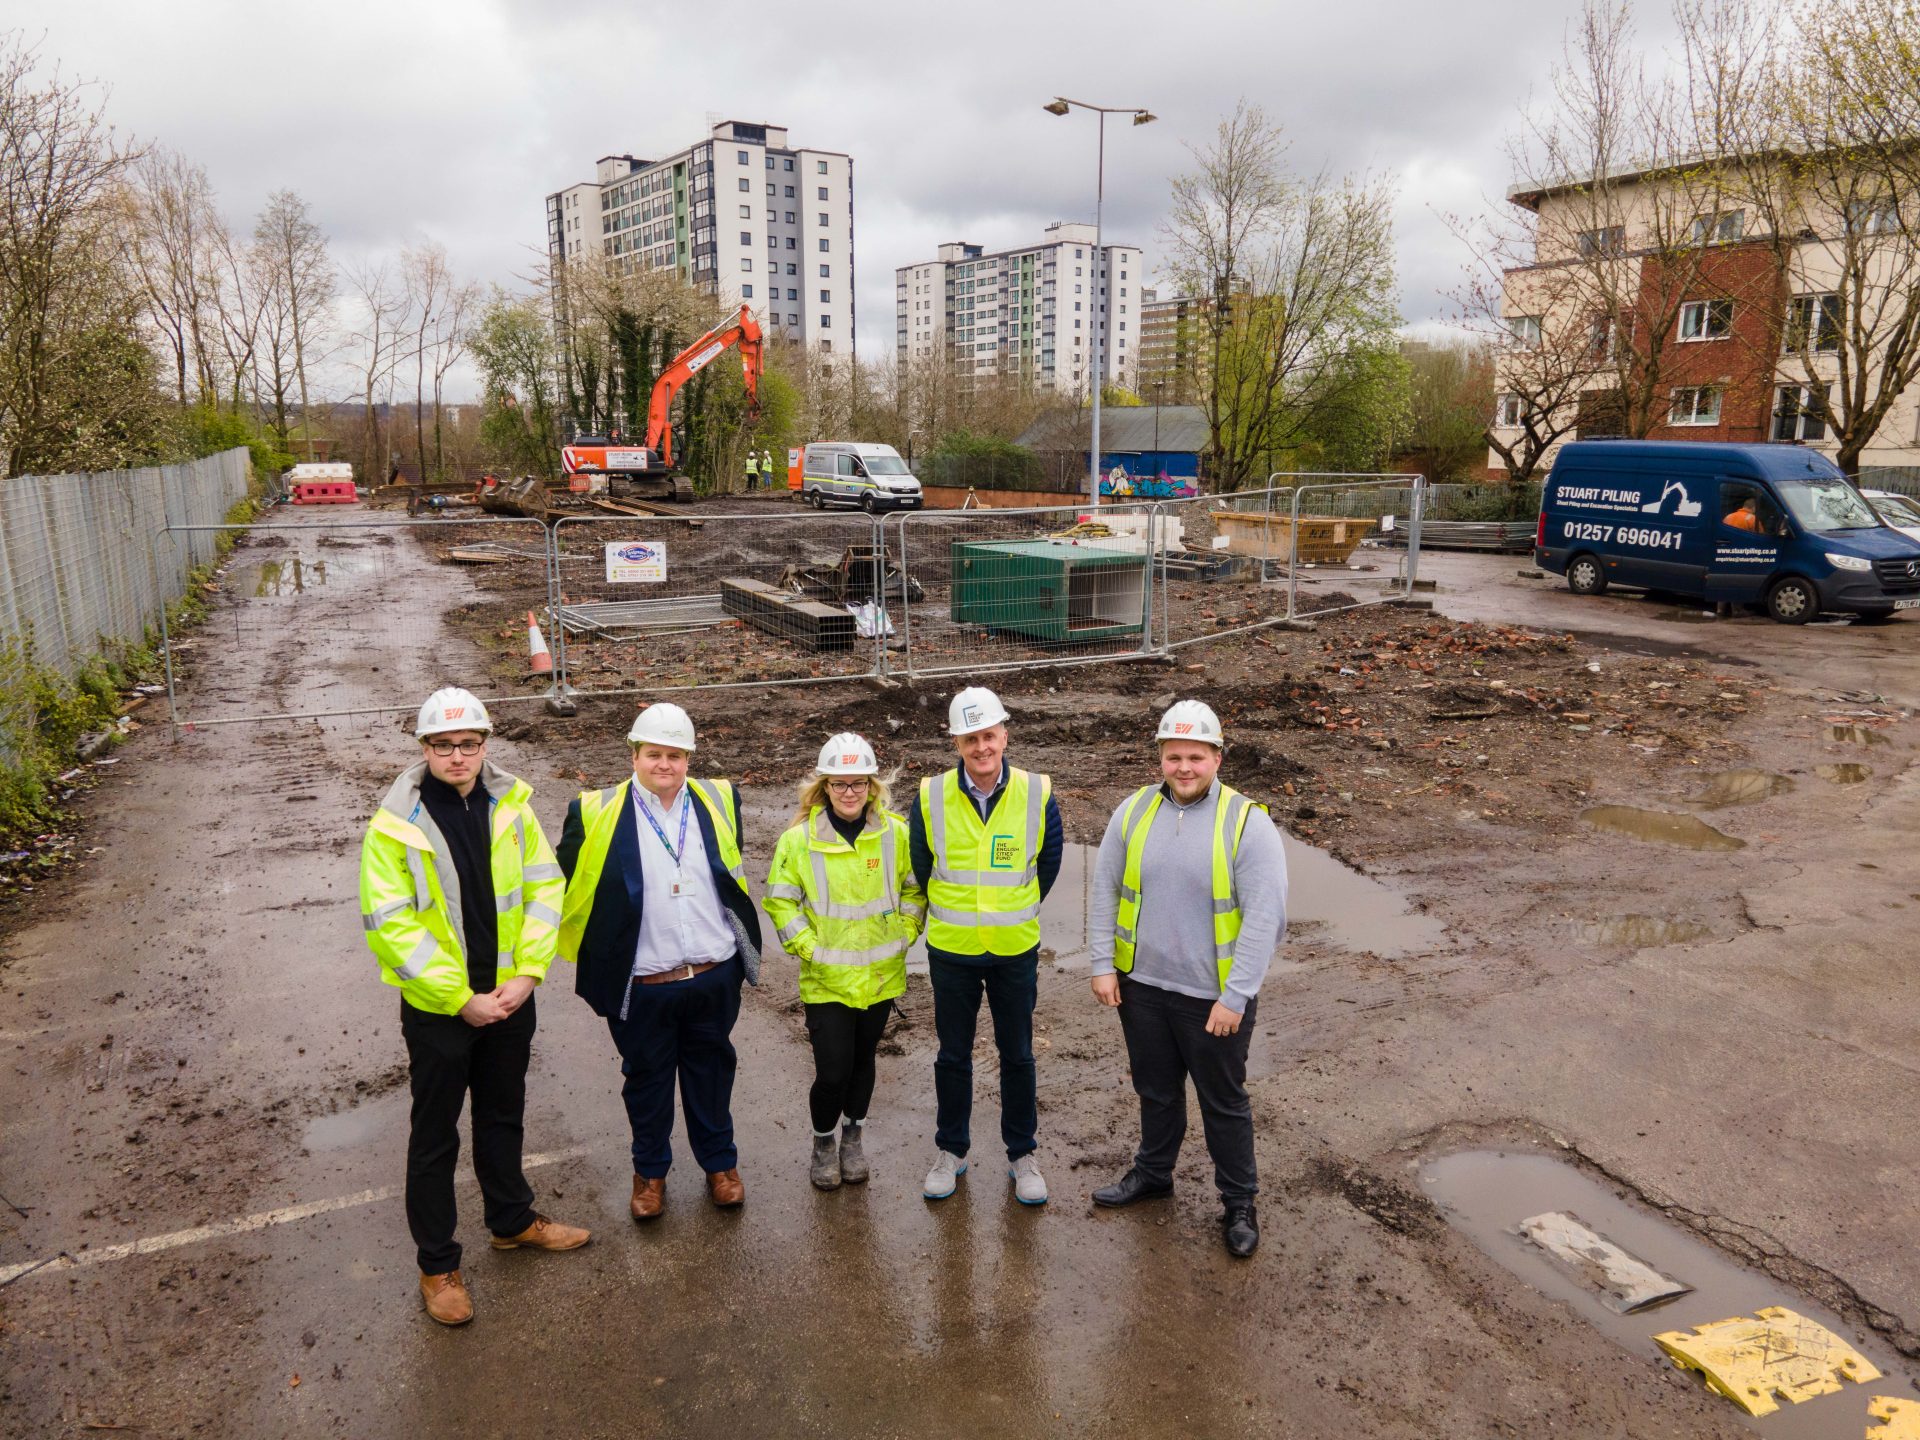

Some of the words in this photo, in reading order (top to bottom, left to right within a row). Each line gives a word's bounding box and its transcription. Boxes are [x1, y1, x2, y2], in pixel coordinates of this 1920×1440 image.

[1557, 486, 1600, 500] STUART
[1601, 490, 1641, 504] PILING
[1613, 504, 1639, 512] Specialists
[1564, 521, 1614, 542] 01257
[1616, 527, 1683, 550] 696041
